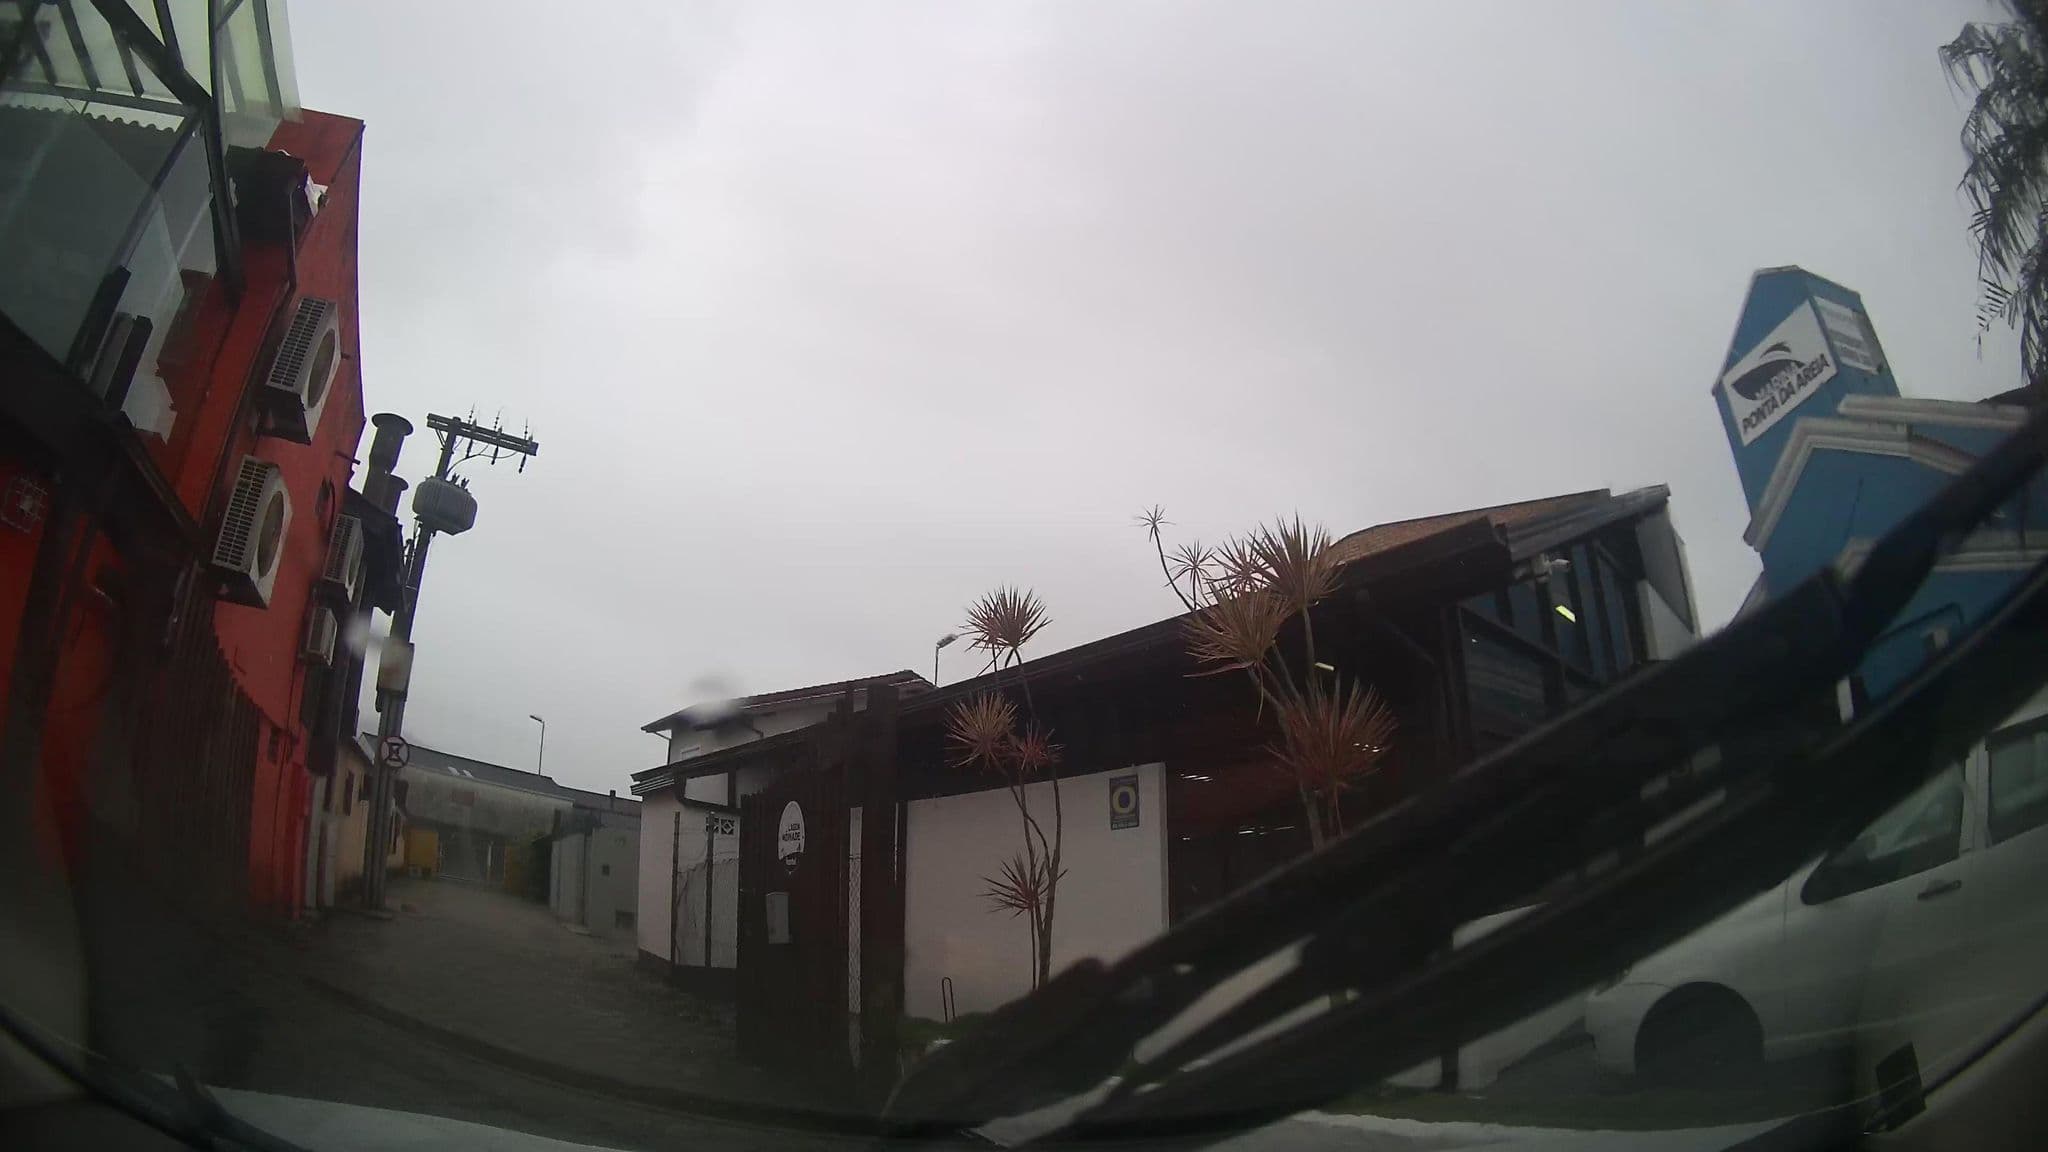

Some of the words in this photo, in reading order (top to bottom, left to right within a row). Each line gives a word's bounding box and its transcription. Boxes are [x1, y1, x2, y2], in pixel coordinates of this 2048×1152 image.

[1742, 396, 1779, 432] PONTA
[1779, 380, 1796, 405] DA
[1796, 353, 1829, 389] AREIA
